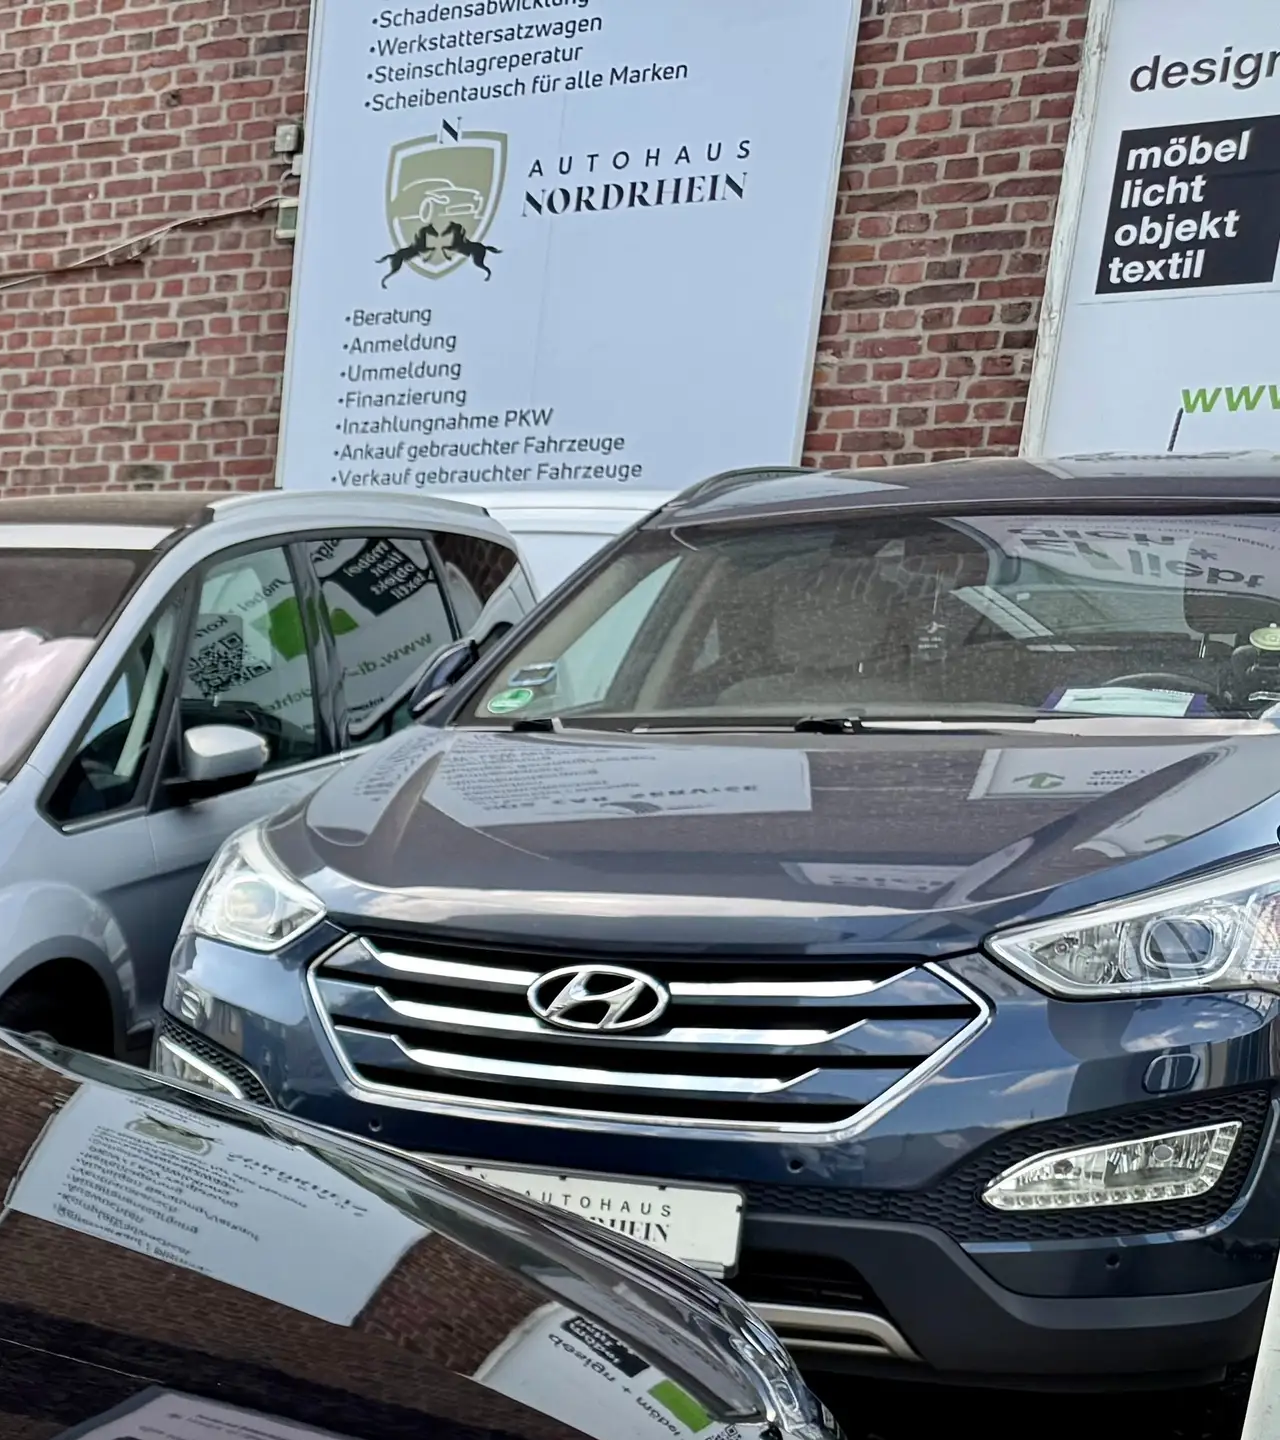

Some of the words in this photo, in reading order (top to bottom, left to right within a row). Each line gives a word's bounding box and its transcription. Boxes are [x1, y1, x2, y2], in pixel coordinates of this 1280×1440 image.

[377, 16, 603, 57] Werkstattersatzwagen
[373, 45, 584, 84] Steinschlagreperatur
[371, 78, 526, 112] Scheibentausch
[532, 74, 562, 97] für
[564, 69, 604, 91] alle
[609, 63, 689, 88] Marken
[528, 139, 752, 178] AUTOHAUS
[1126, 130, 1253, 172] möbel
[520, 171, 749, 218] NORDRHEIN
[1120, 175, 1207, 211] licht
[1113, 209, 1241, 252] objekt
[1108, 249, 1205, 286] textil
[352, 307, 433, 327] Beratung
[349, 333, 458, 355] Anmeldung
[347, 360, 462, 383] Ummeldung
[345, 387, 468, 409] Finanzierung
[342, 413, 500, 436] Inzahlungnahme
[504, 407, 555, 428] PKW
[339, 441, 405, 462] Ankauf
[407, 438, 520, 463] gebrauchter
[523, 434, 626, 457] Fahrzeuge
[338, 467, 412, 488] Verkauf
[414, 465, 532, 490] gebrauchter
[536, 461, 644, 482] Fahrzeuge
